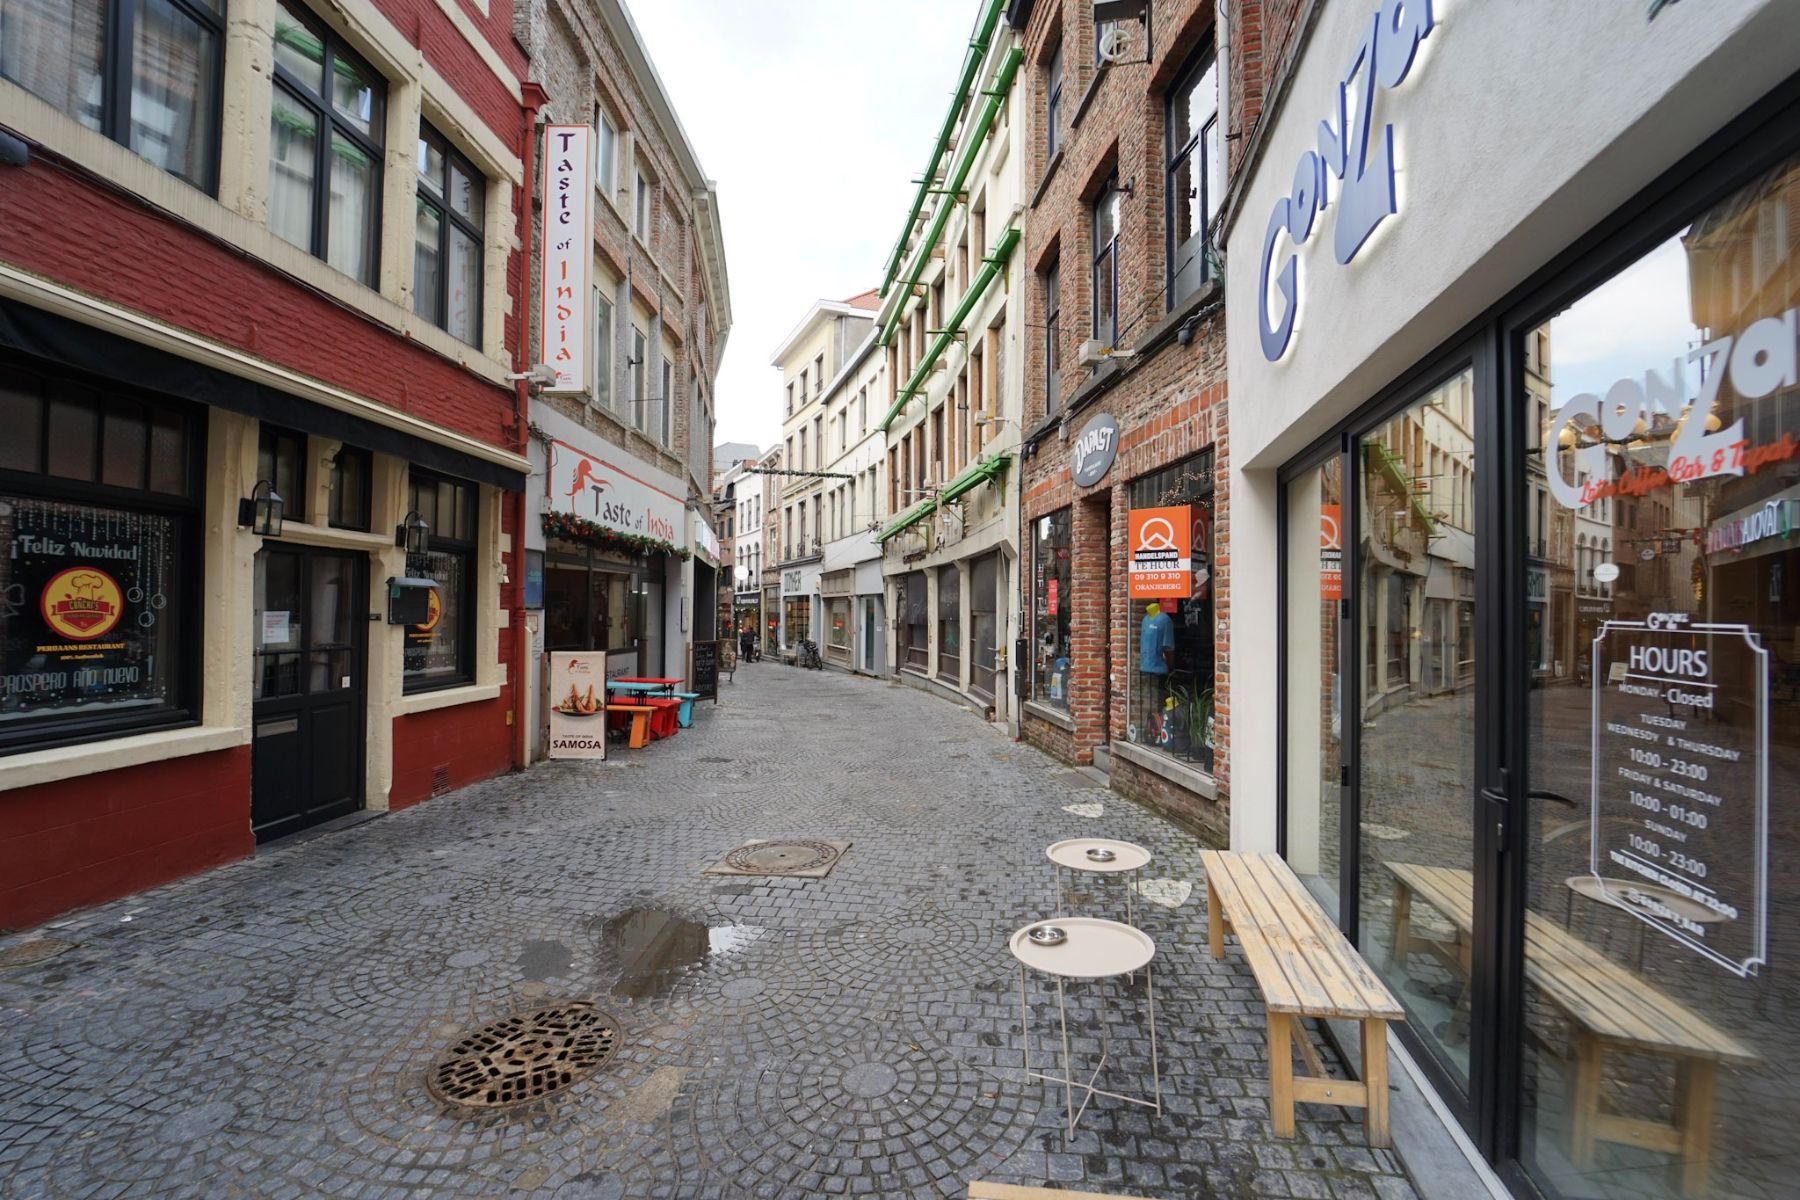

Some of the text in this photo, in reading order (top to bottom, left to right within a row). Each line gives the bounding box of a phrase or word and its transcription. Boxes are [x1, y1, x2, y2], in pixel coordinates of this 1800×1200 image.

[557, 133, 576, 225] Taste
[556, 239, 572, 250] of
[591, 485, 674, 540] Taste of India
[70, 542, 137, 560] Navidad
[1135, 560, 1180, 570] TE HUUR
[1135, 583, 1181, 591] ORANJEBERG
[1630, 645, 1708, 677] HOURS
[1618, 683, 1661, 699] MONDAY
[1667, 688, 1713, 708] Closed
[1640, 714, 1687, 730] TUESDAY
[553, 740, 602, 750] SAMOSA
[1606, 722, 1741, 762] WEDNESDY & THURSDAY
[1630, 748, 1661, 768] 10:00
[1669, 758, 1708, 781] 23:00
[1618, 767, 1722, 807] FRIDAY & SATURDAY
[1629, 790, 1660, 812] 10:00
[1669, 804, 1708, 829] 01:00
[1644, 819, 1687, 842] SUNDAY
[1629, 834, 1660, 857] 10:00
[1669, 850, 1707, 877] 23:00
